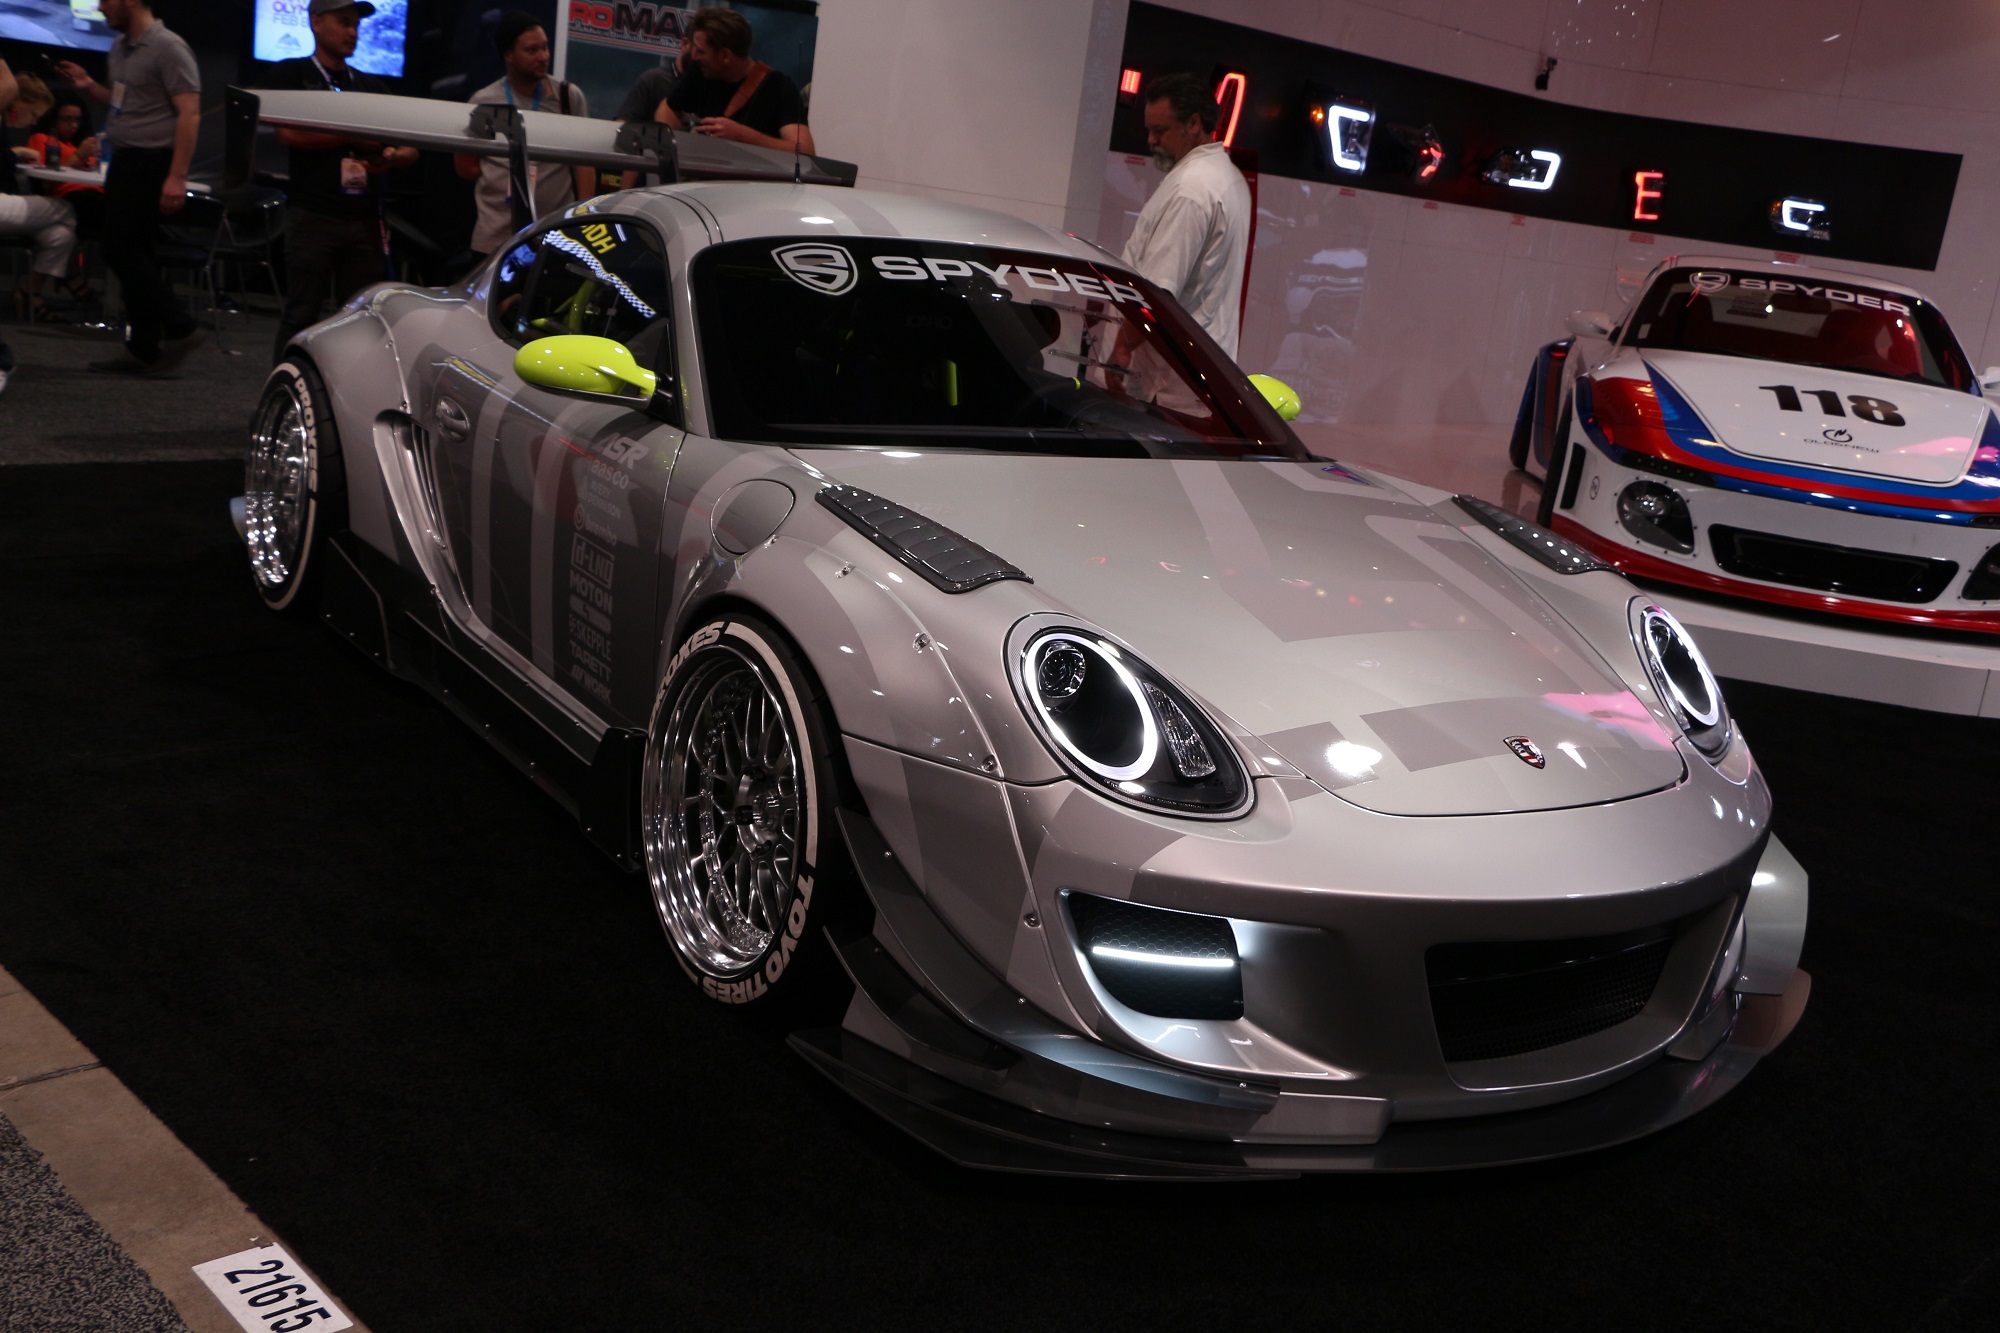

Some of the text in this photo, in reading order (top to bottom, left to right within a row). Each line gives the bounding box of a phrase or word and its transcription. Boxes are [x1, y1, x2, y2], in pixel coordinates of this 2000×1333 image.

[871, 255, 1153, 310] SPYDER
[1738, 277, 1911, 317] SPYDER
[1758, 384, 1906, 427] 118
[295, 377, 317, 493] PROXES
[592, 431, 649, 470] ASR
[570, 569, 613, 615] MOTON
[584, 673, 612, 705] WORK
[702, 874, 815, 1005] TOYO TIRES
[223, 1259, 332, 1333] 21615
